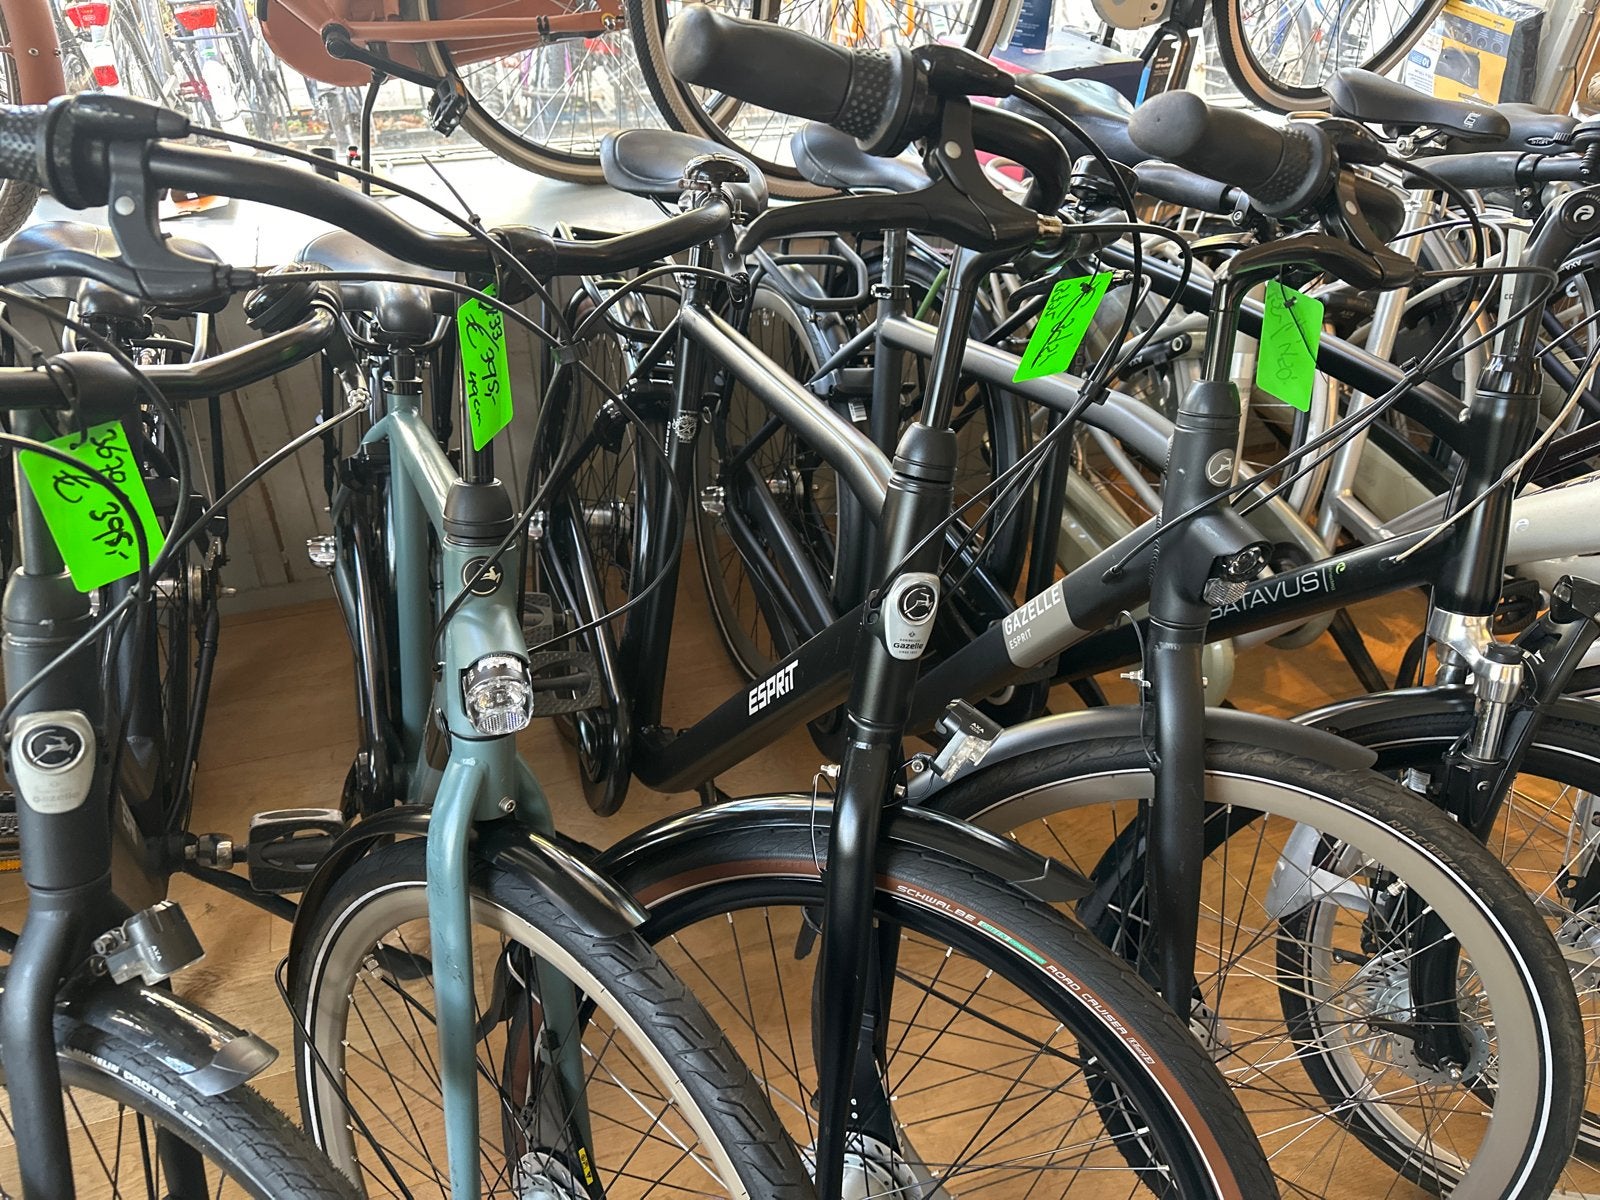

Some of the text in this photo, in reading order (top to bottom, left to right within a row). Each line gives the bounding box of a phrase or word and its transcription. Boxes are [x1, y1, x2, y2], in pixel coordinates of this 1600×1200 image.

[90, 428, 128, 484] 3670
[1004, 584, 1061, 636] GAZELLE
[893, 642, 924, 650] Gazelle
[1008, 628, 1032, 650] ESPRIT
[970, 722, 985, 734] AXA
[896, 885, 977, 922] SCHWALBE
[151, 945, 162, 961] AXA
[1046, 965, 1128, 1035] ROAD CRUISER
[123, 1070, 177, 1110] PROTEK
